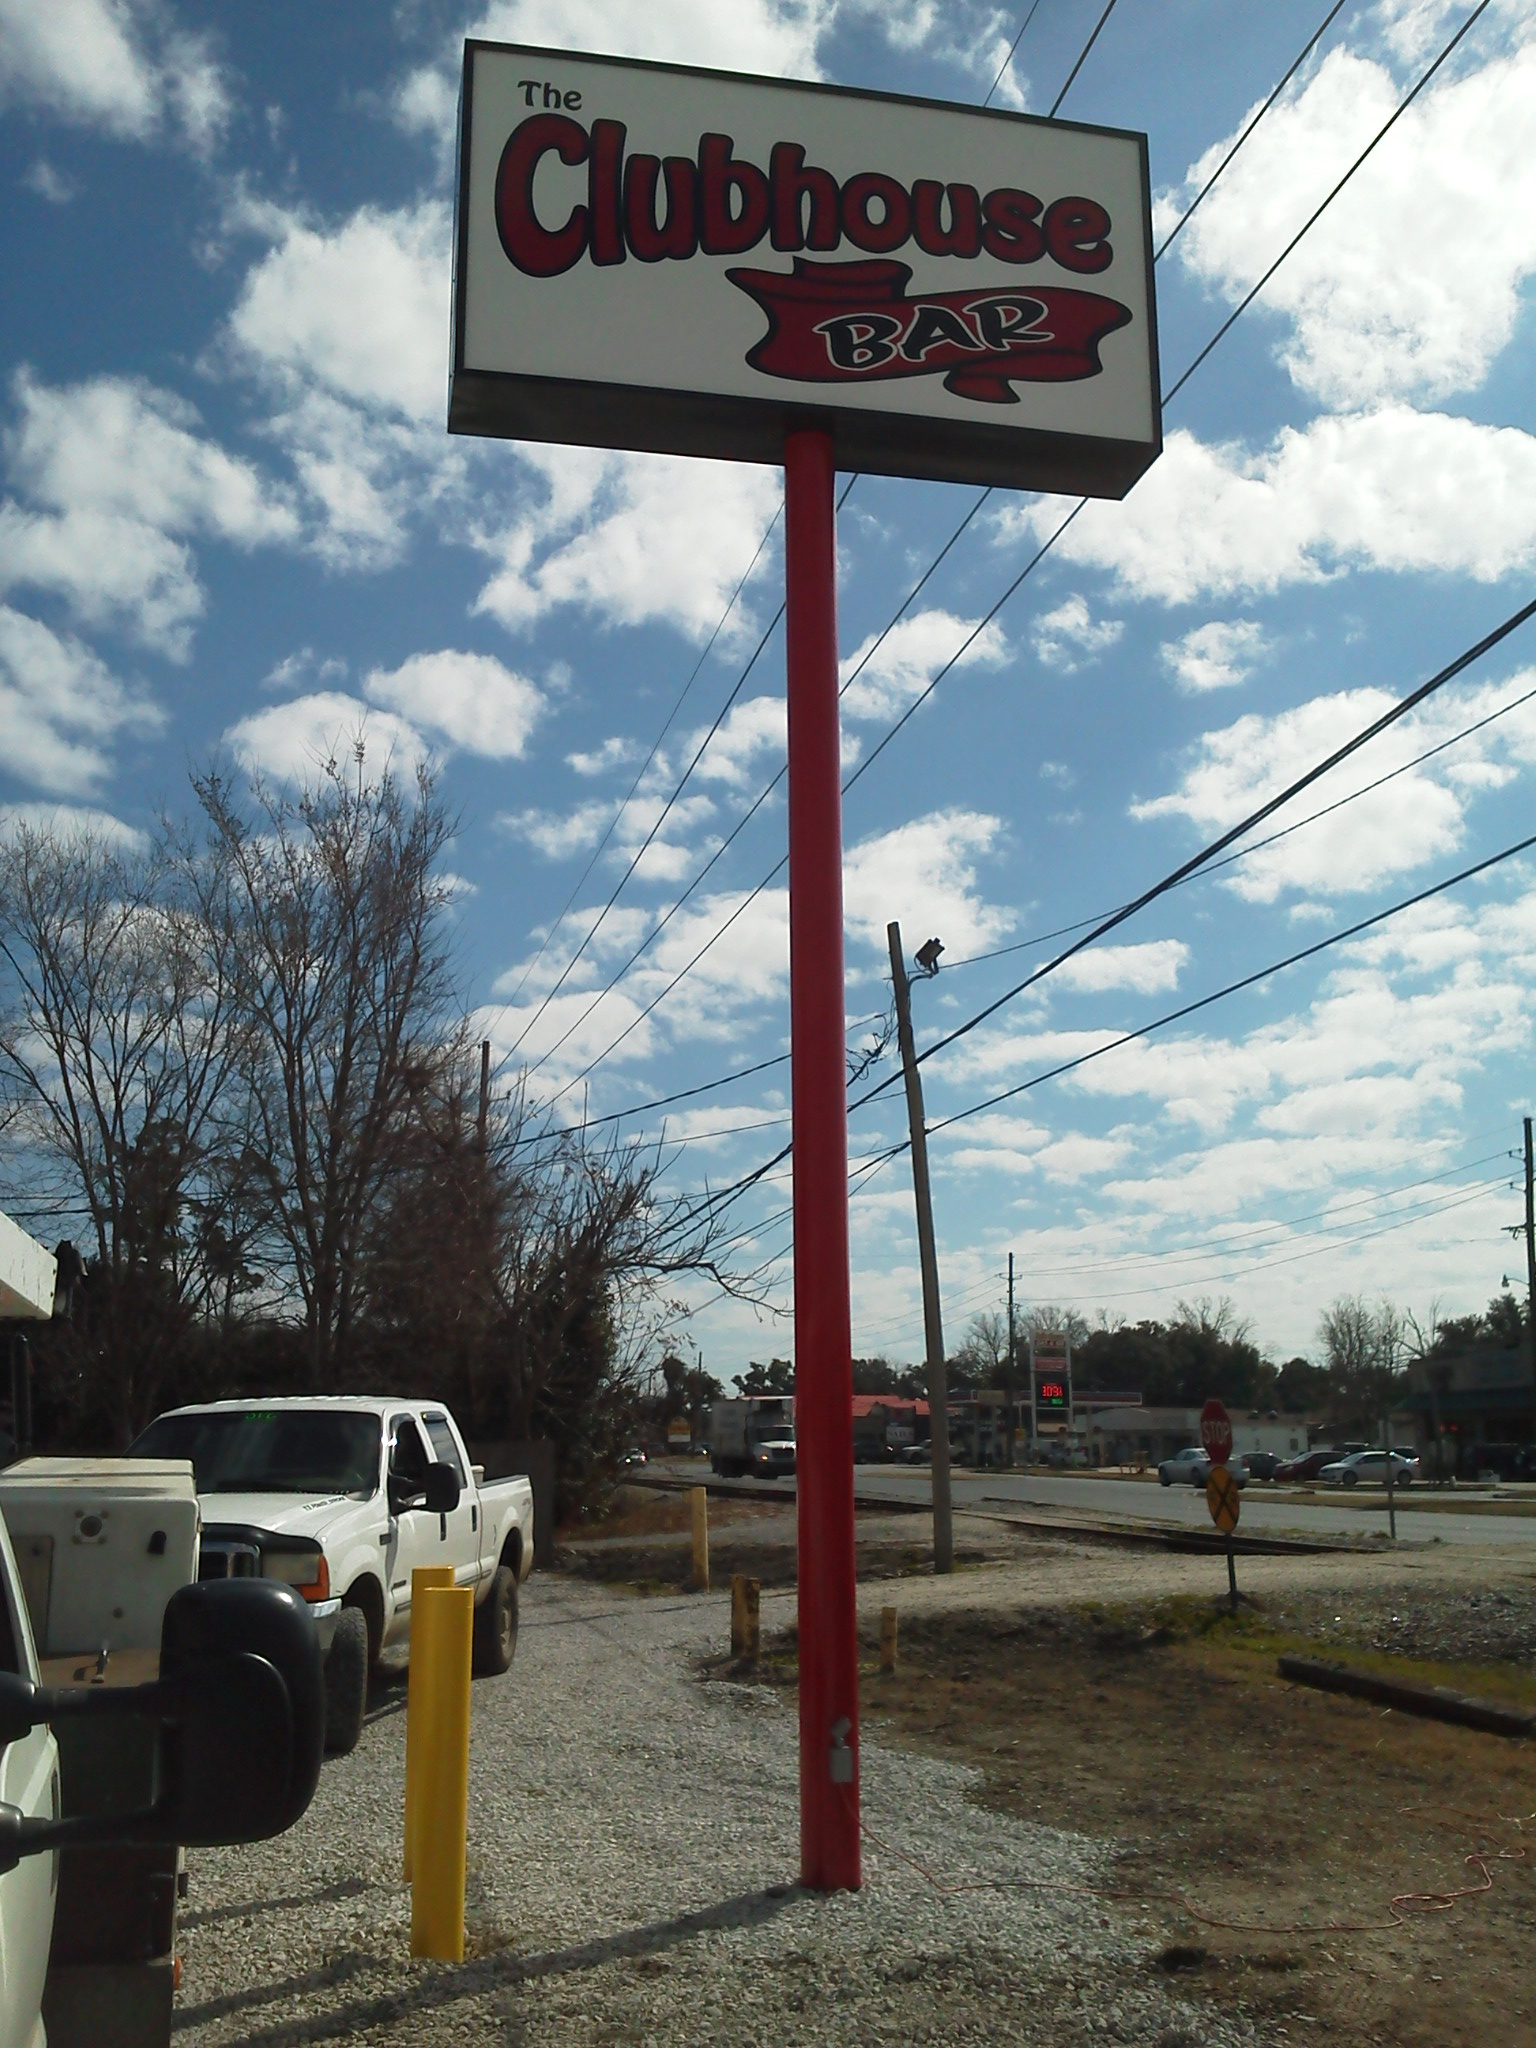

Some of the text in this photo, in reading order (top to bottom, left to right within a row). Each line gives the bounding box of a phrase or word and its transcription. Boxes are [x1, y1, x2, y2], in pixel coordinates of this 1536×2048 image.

[517, 80, 582, 111] The
[494, 112, 1114, 278] Clubhouse
[812, 295, 1055, 371] BAR
[1202, 1420, 1230, 1444] STOP
